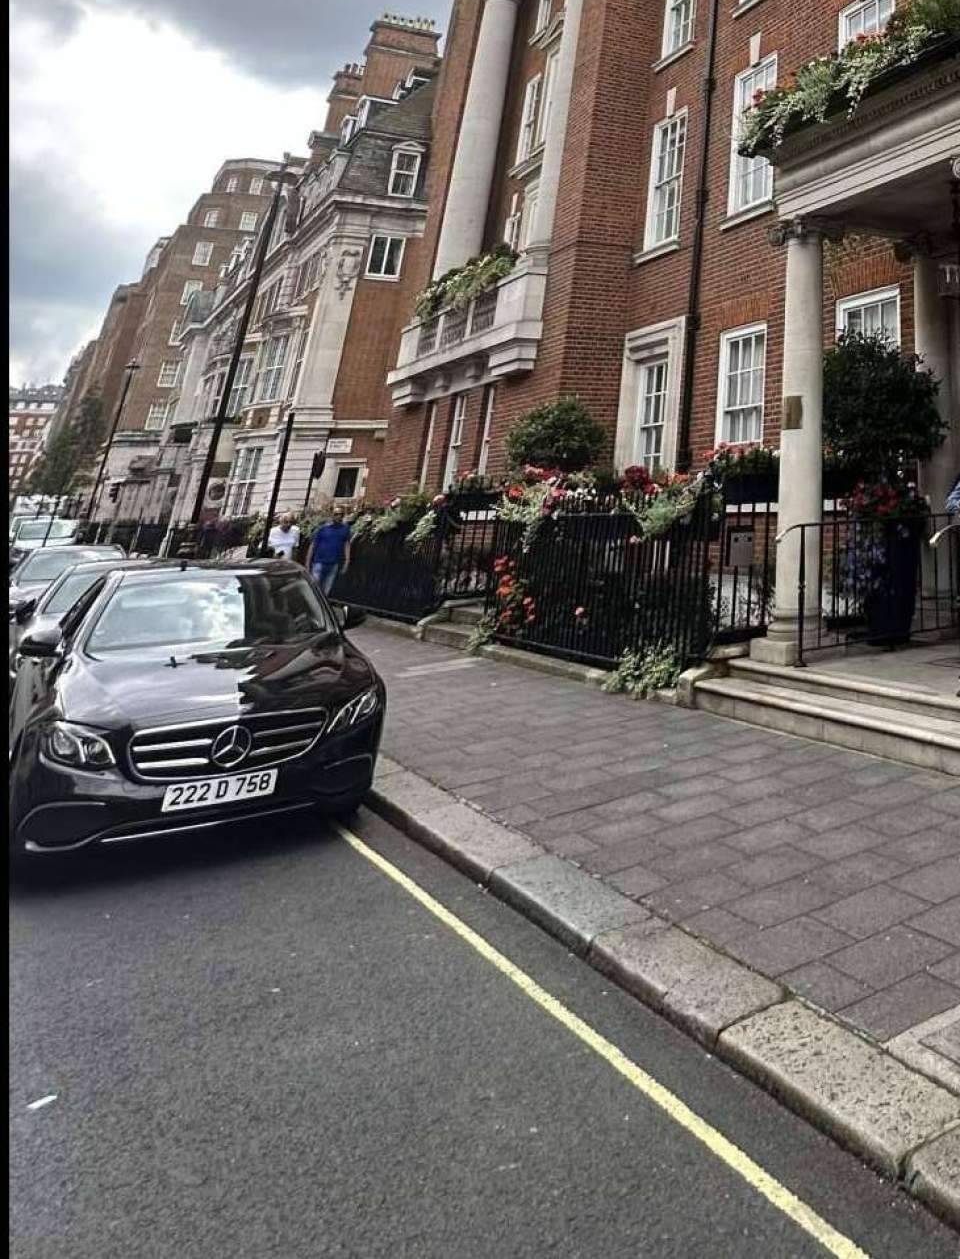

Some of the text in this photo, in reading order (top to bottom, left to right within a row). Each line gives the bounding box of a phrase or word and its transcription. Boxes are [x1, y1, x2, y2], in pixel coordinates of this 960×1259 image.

[169, 773, 271, 806] 222 D 758
